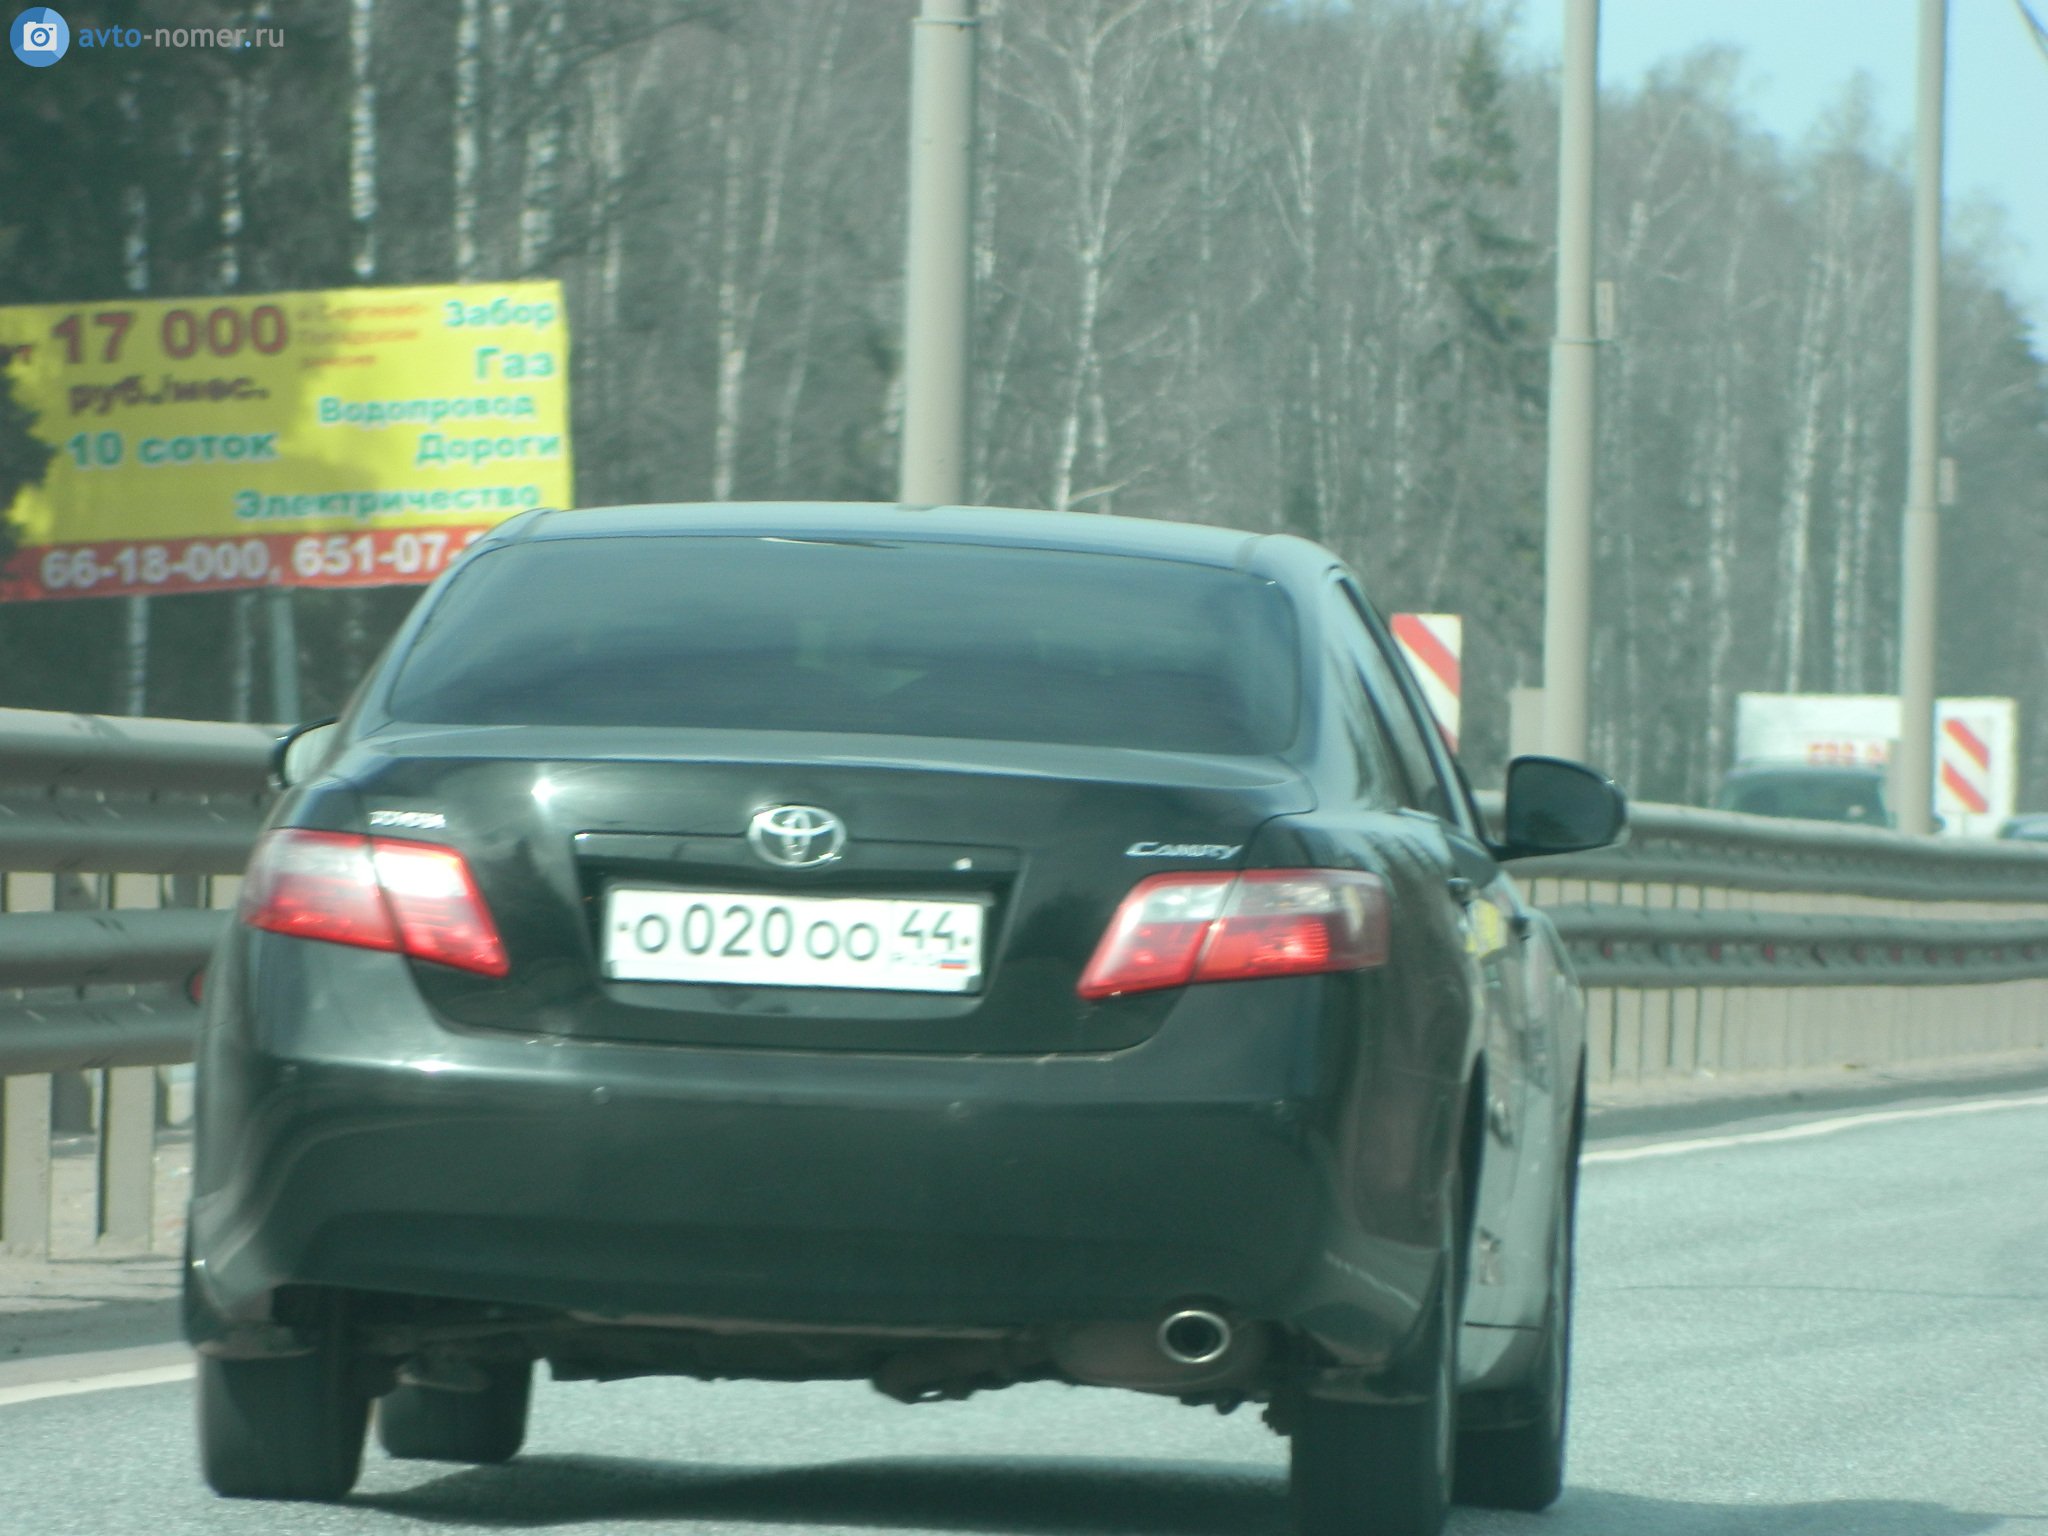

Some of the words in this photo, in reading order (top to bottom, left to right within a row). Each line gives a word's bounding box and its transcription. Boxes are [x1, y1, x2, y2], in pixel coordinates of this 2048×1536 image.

[443, 300, 555, 331] Забор
[53, 310, 134, 365] 17
[161, 305, 288, 361] 000
[475, 347, 555, 380] Газ
[319, 396, 535, 425] Водопровод
[67, 430, 124, 466] 10
[138, 430, 279, 465] соток
[415, 432, 560, 466] Дороги
[234, 484, 540, 521] Электричество
[40, 540, 281, 590] 66-18-000,
[292, 530, 485, 576] 651-07-
[899, 909, 955, 952] 44
